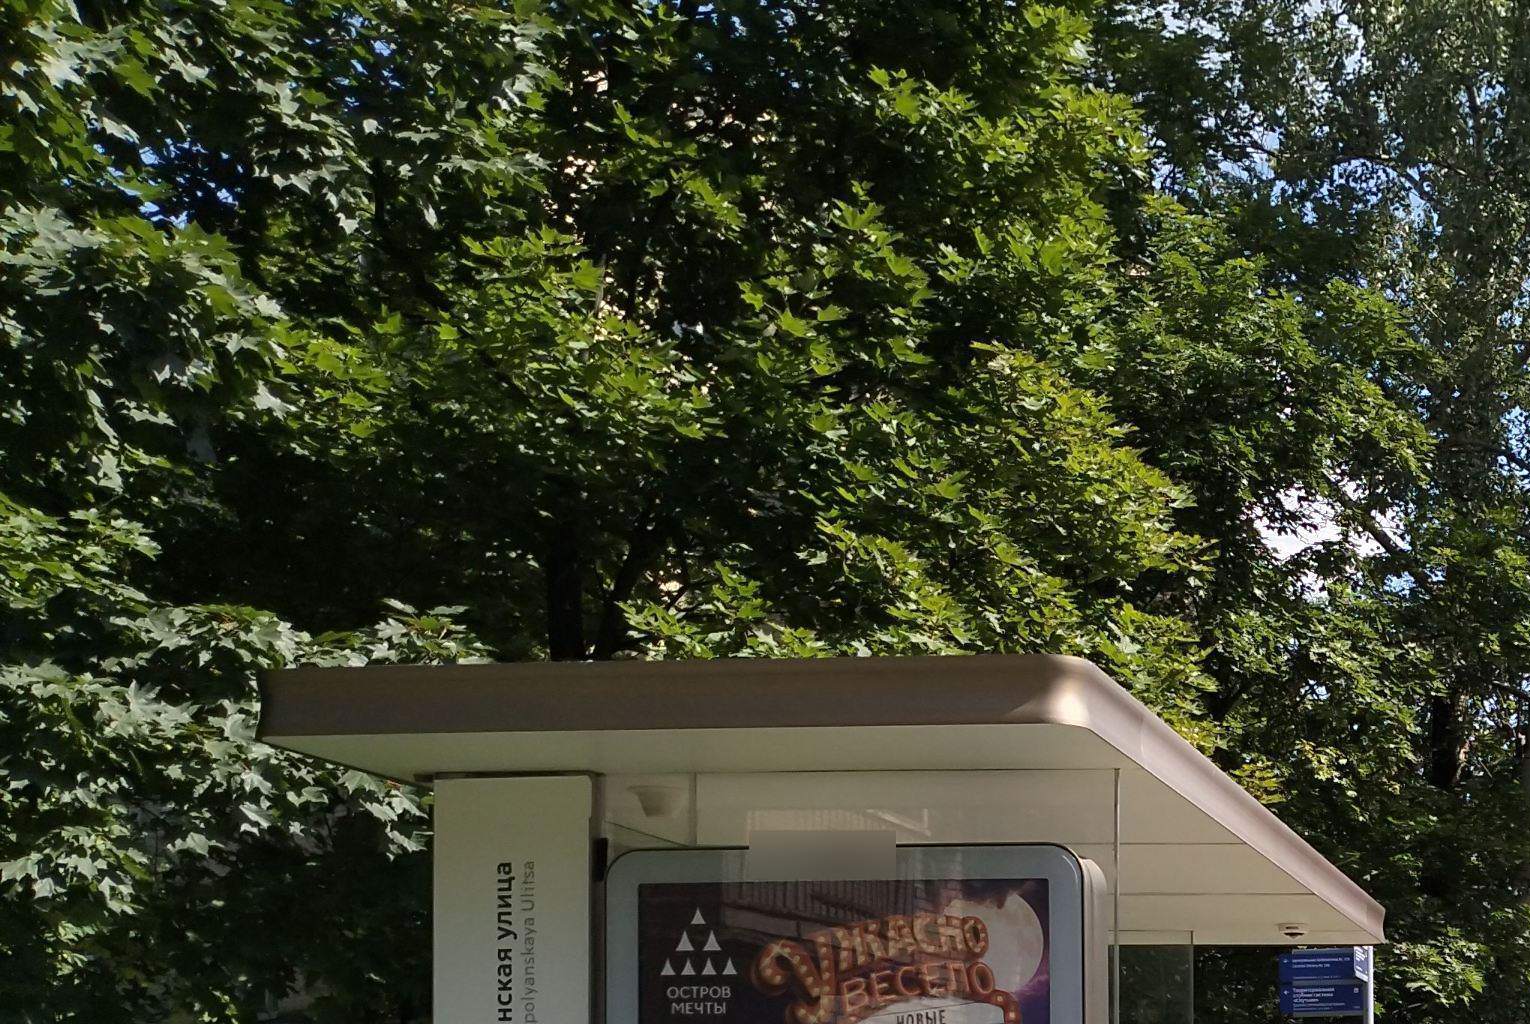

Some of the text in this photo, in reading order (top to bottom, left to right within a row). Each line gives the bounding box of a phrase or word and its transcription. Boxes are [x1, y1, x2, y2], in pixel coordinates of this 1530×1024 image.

[496, 861, 518, 940] улица
[522, 860, 536, 911] Ulitsa
[666, 984, 732, 1000] ОСТРОВ
[671, 1002, 727, 1015] МЕЧТЫ
[840, 961, 995, 1013] ВЕСЕЛО
